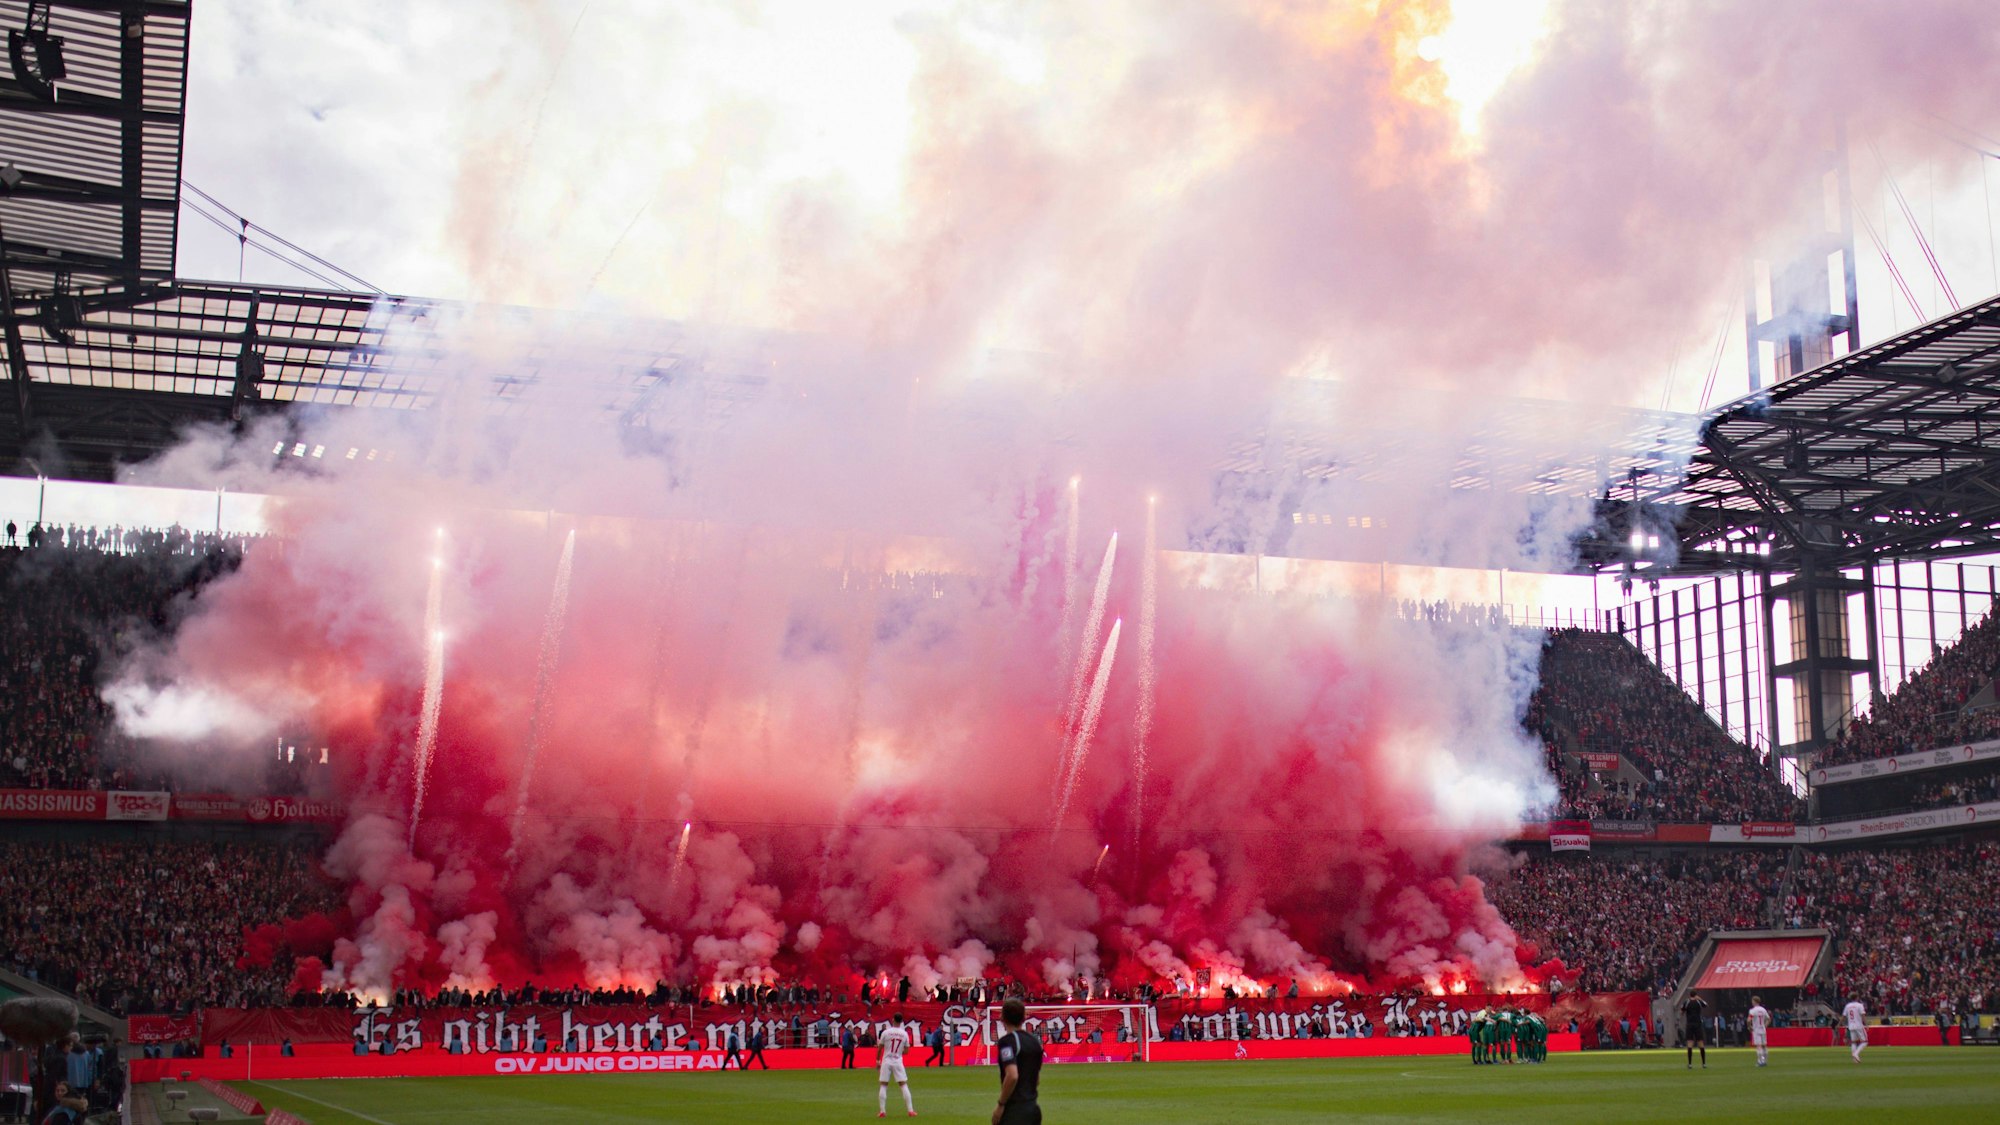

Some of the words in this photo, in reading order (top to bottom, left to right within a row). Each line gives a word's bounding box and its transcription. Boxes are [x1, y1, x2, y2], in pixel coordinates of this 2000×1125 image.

[0, 793, 97, 813] ASSISMUS
[176, 800, 240, 810] GEROLSTEIN
[1553, 838, 1589, 847] Slovakia
[1714, 964, 1800, 974] Energie
[1726, 960, 1788, 969] Rhein
[352, 1007, 422, 1053] Es
[561, 1008, 688, 1053] heute
[891, 1038, 902, 1054] 17
[493, 1058, 535, 1073] OV
[538, 1057, 614, 1072] JUNG
[618, 1055, 693, 1071] ODER
